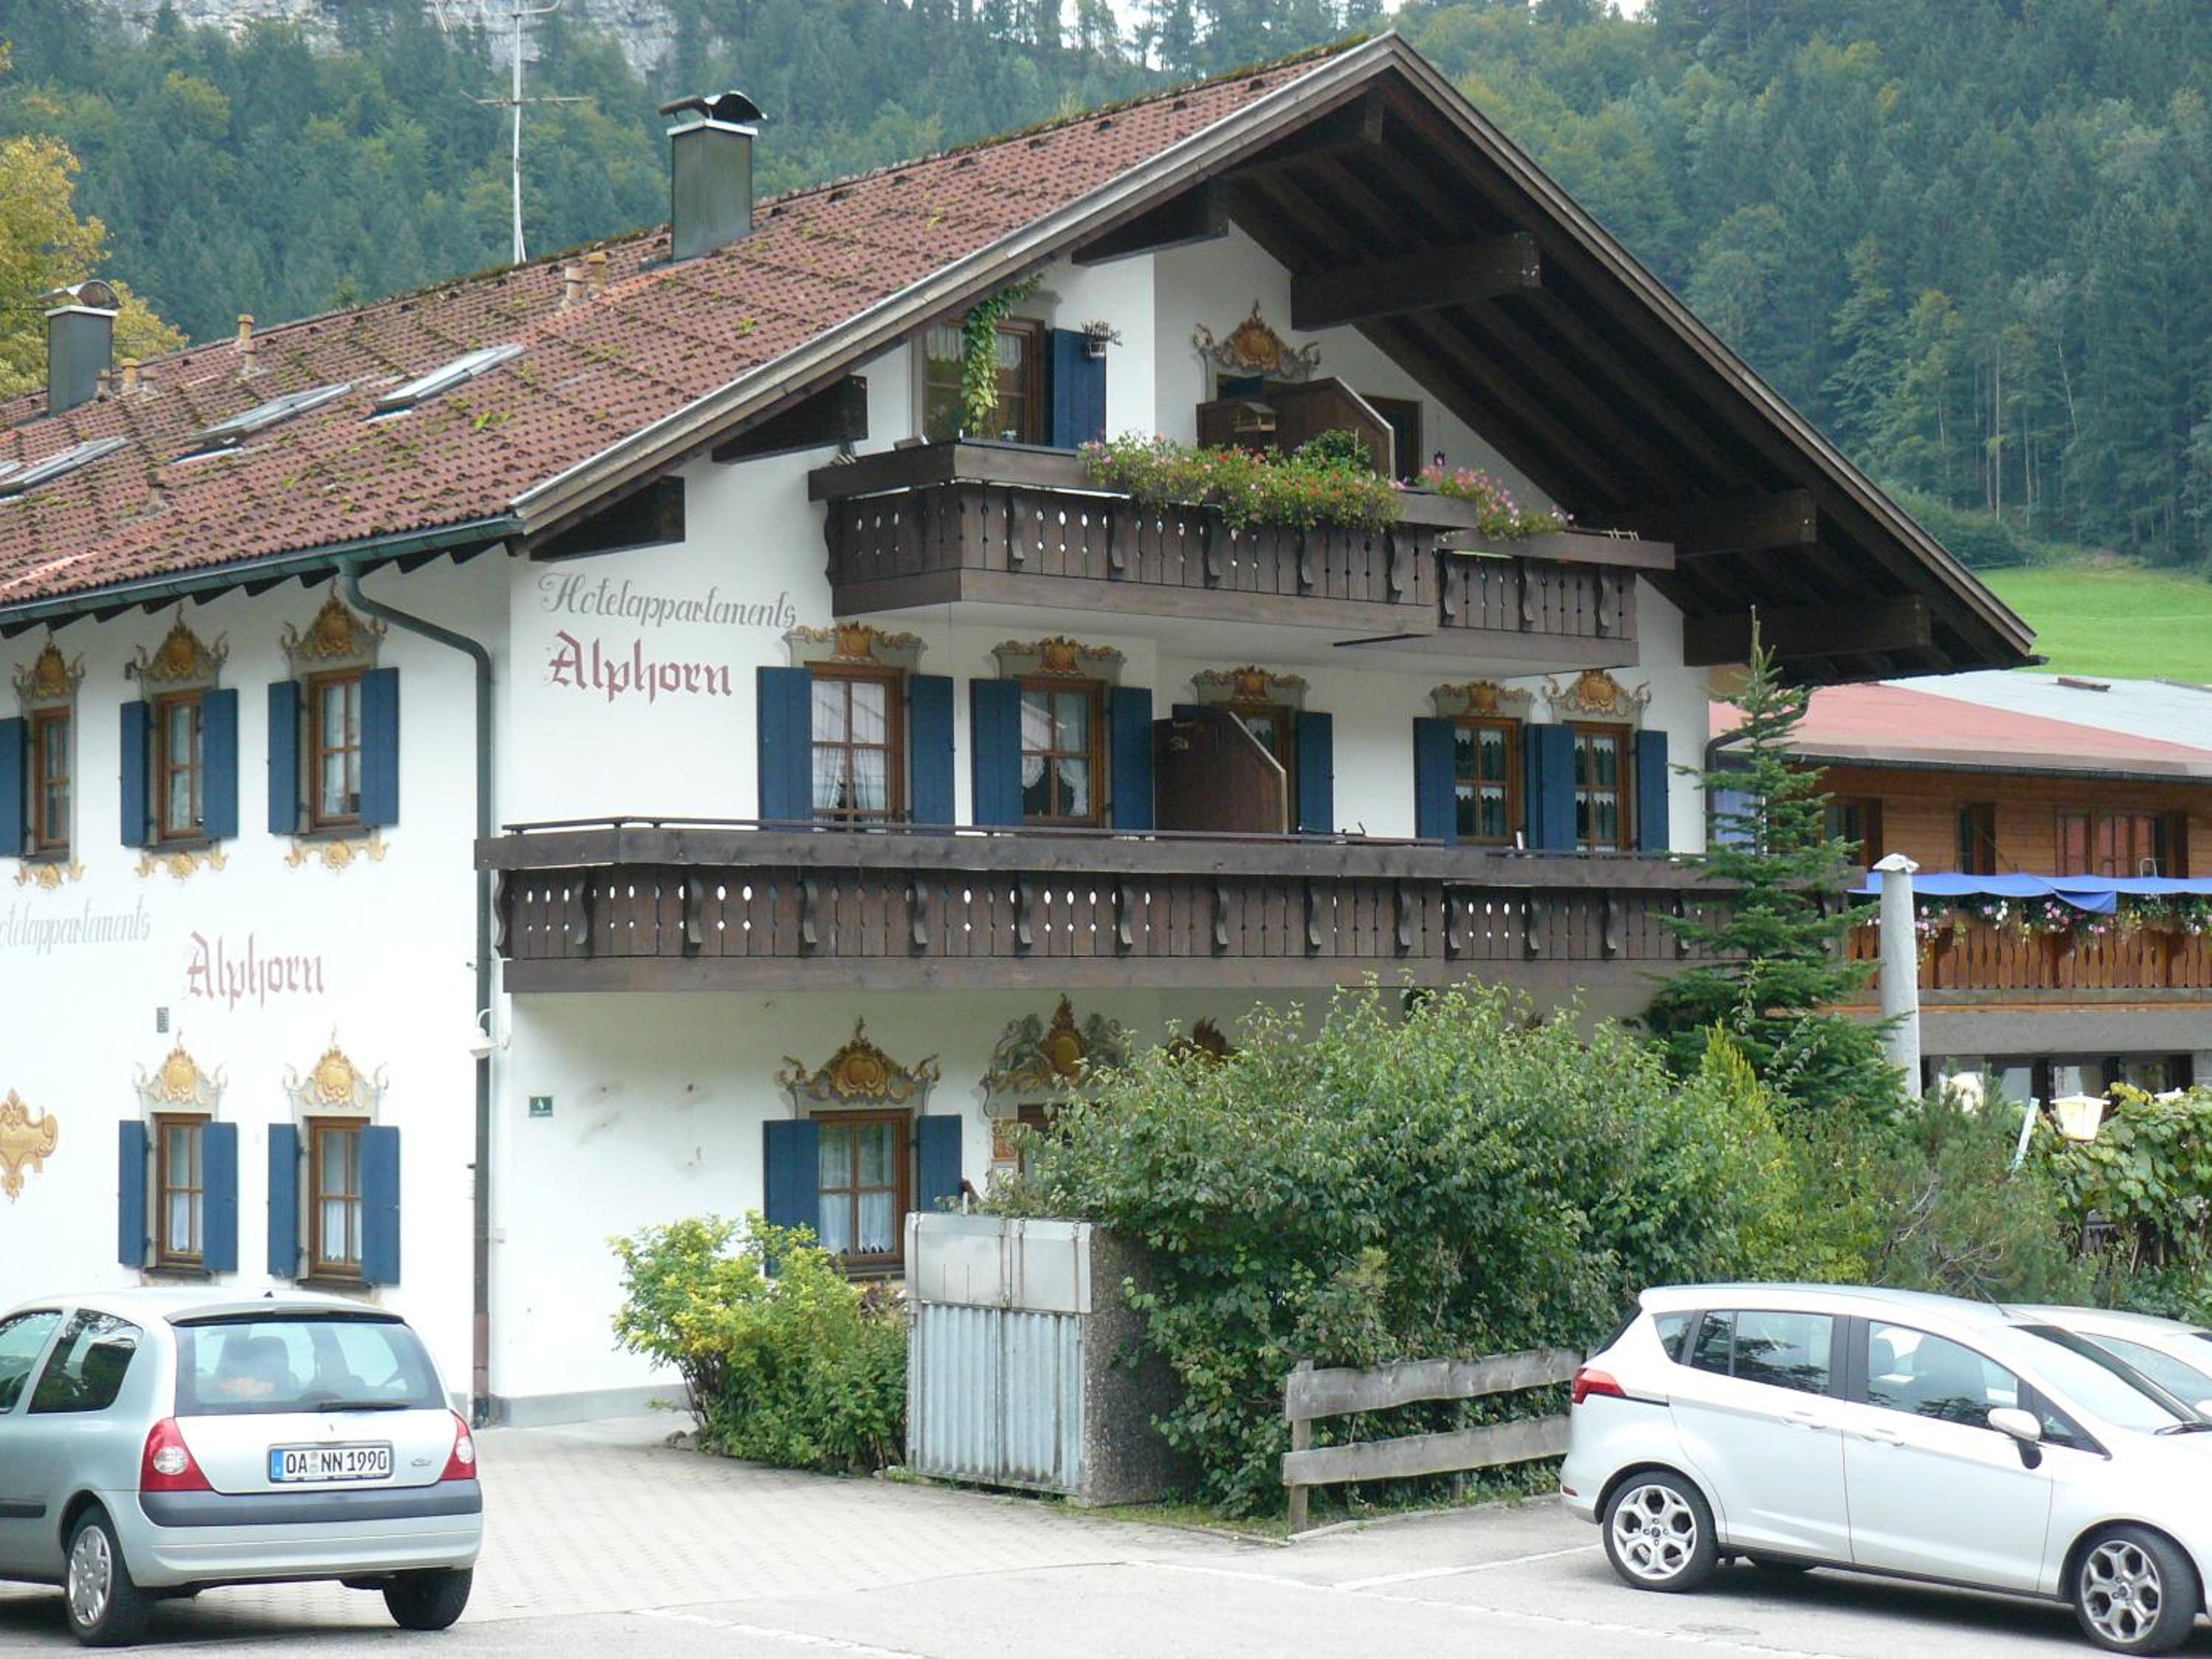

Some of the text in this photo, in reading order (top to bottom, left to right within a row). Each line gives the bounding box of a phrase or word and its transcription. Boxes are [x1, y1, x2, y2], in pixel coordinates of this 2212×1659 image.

[539, 572, 796, 628] Hotelappartements
[546, 630, 732, 703] Alphorn
[0, 894, 151, 956] otelappartements
[187, 929, 325, 1012] Alphorn
[285, 1453, 307, 1474] OA
[321, 1452, 343, 1473] NN
[347, 1450, 387, 1472] 1990
